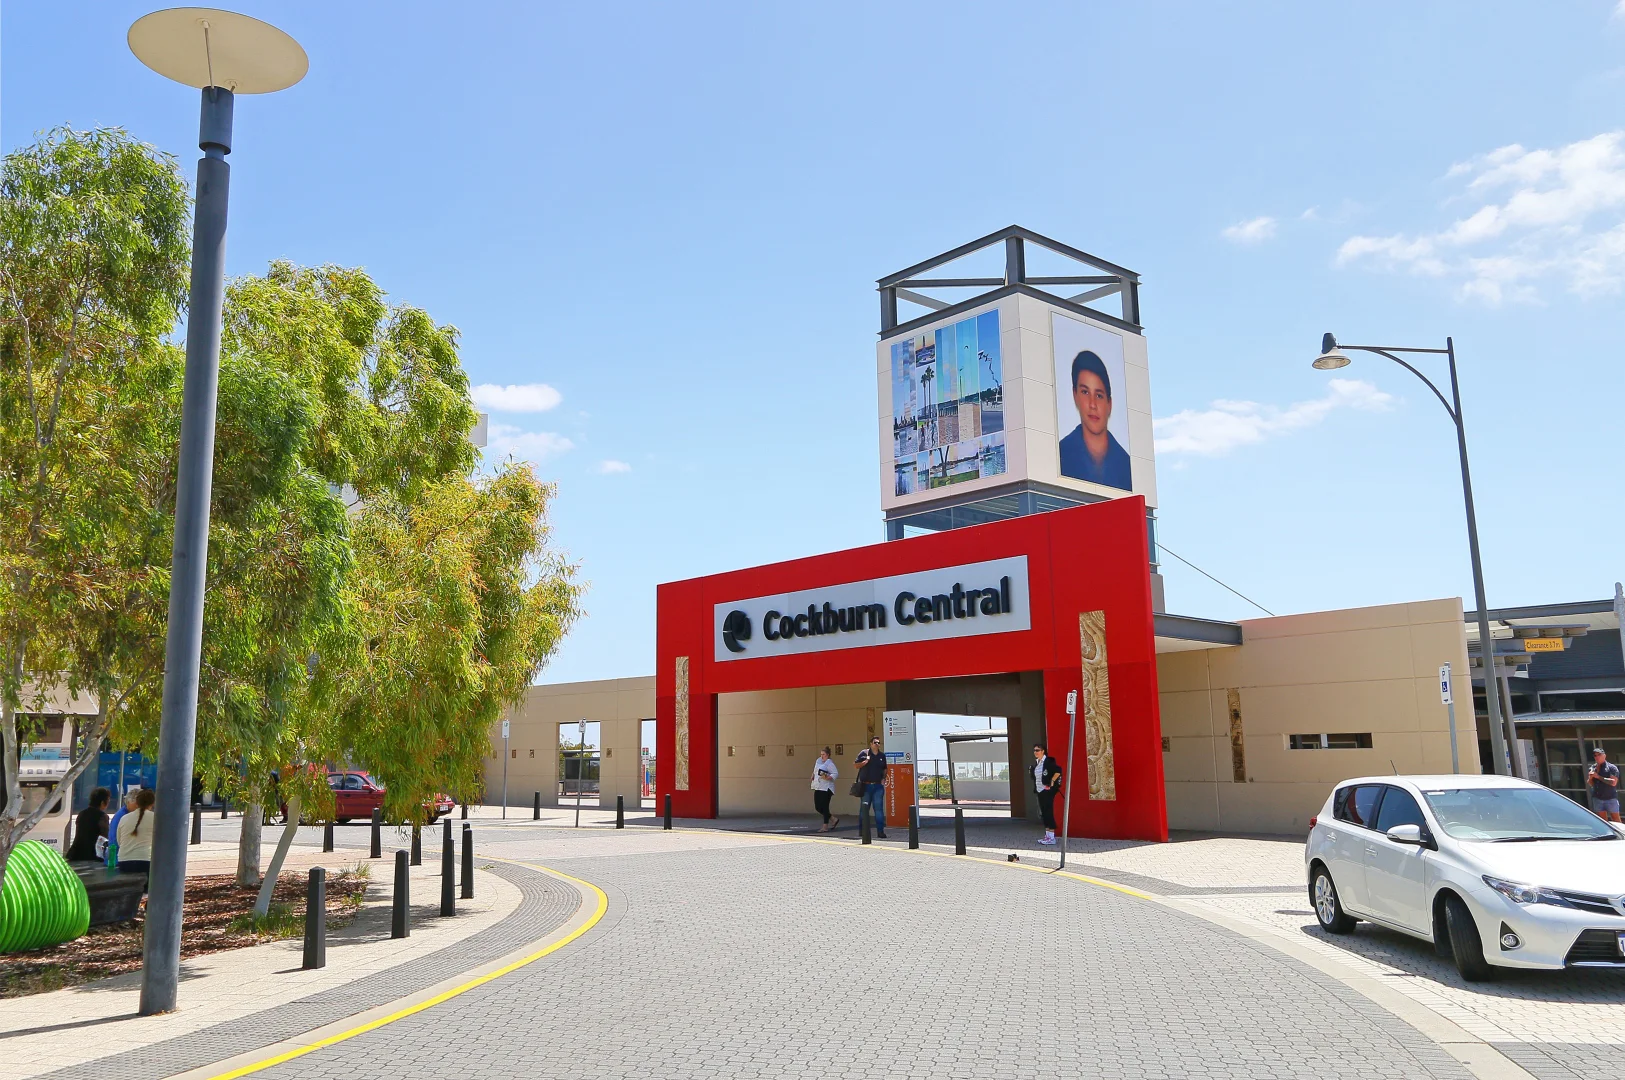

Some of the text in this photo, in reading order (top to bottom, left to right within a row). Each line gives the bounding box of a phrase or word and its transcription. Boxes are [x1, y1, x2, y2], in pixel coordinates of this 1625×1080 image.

[763, 575, 1011, 641] Cockburn Central
[1526, 641, 1549, 649] Clearance
